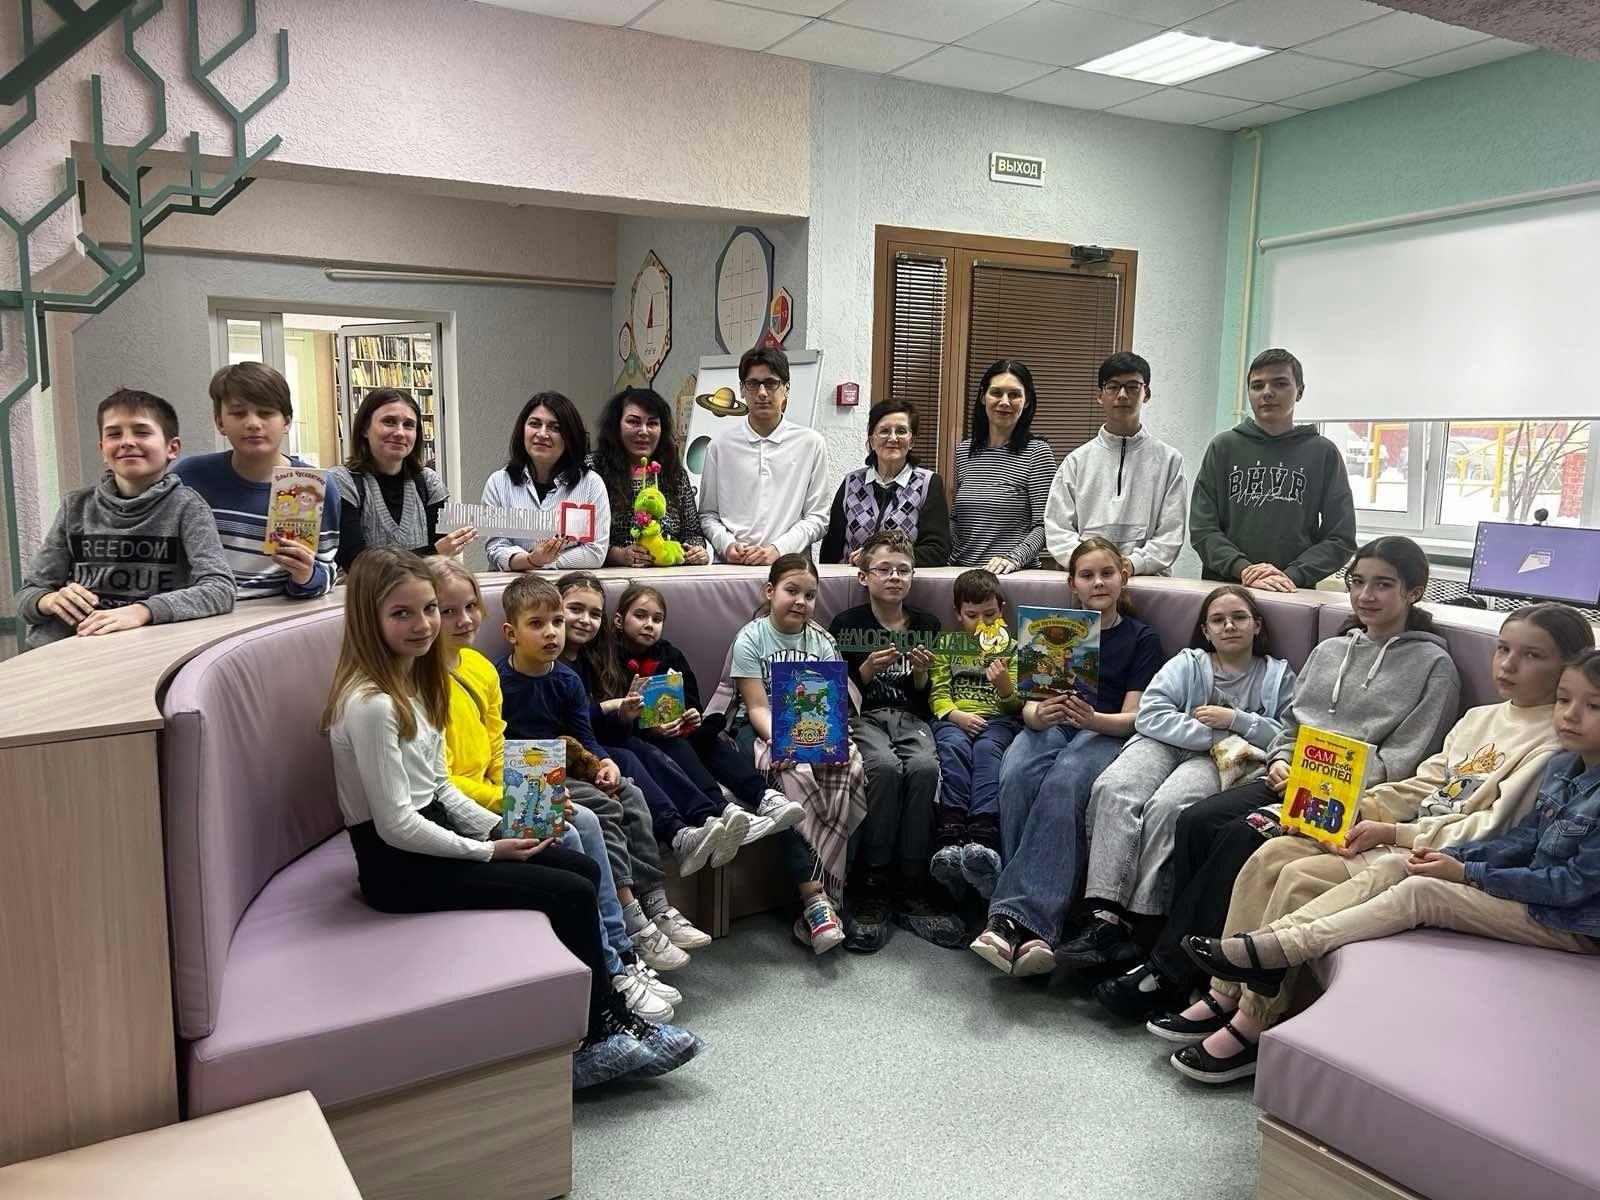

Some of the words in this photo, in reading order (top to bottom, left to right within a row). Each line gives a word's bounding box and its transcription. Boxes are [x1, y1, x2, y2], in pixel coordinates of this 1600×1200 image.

[998, 159, 1039, 177] ВЫХОД
[1229, 467, 1307, 504] BHVR
[81, 540, 168, 559] REEDOM
[1306, 747, 1334, 764] САМ
[1301, 758, 1352, 784] ЛОГОПЕД
[1335, 762, 1353, 773] себе
